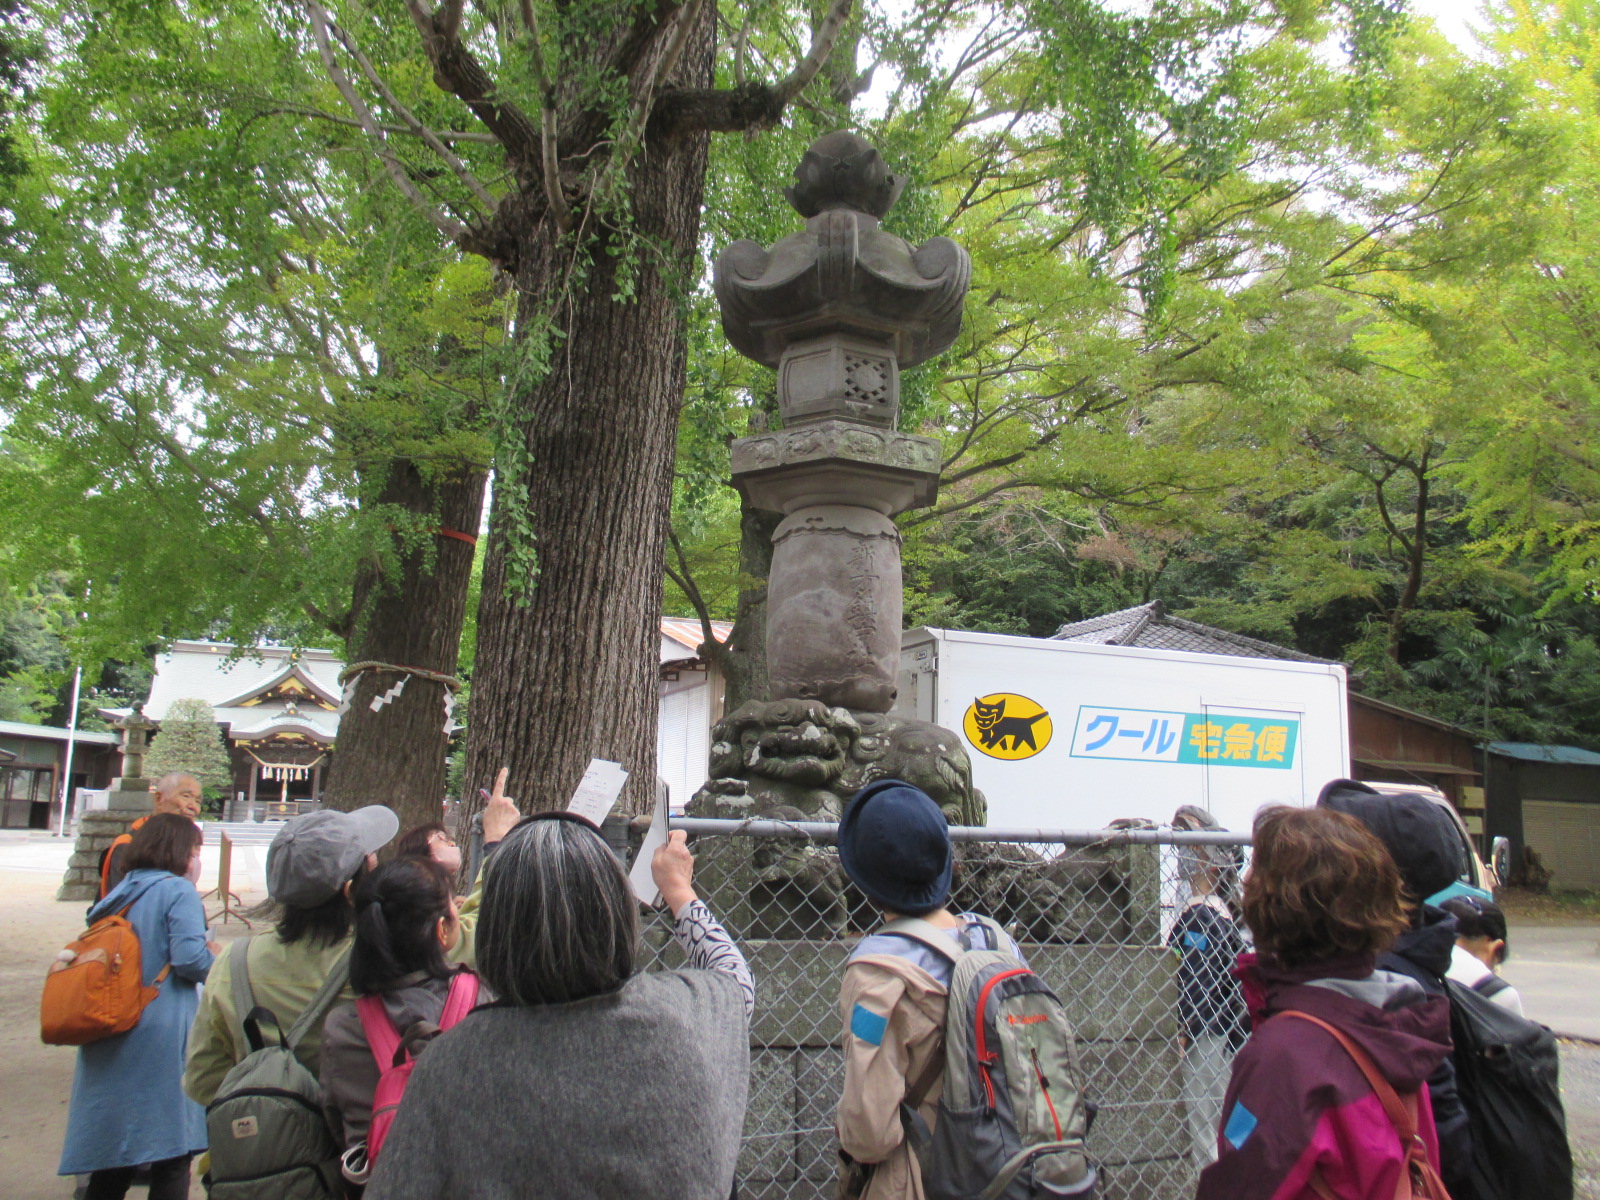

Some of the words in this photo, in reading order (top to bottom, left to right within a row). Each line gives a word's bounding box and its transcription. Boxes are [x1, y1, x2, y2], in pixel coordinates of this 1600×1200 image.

[1085, 715, 1288, 762] クール宅急便
